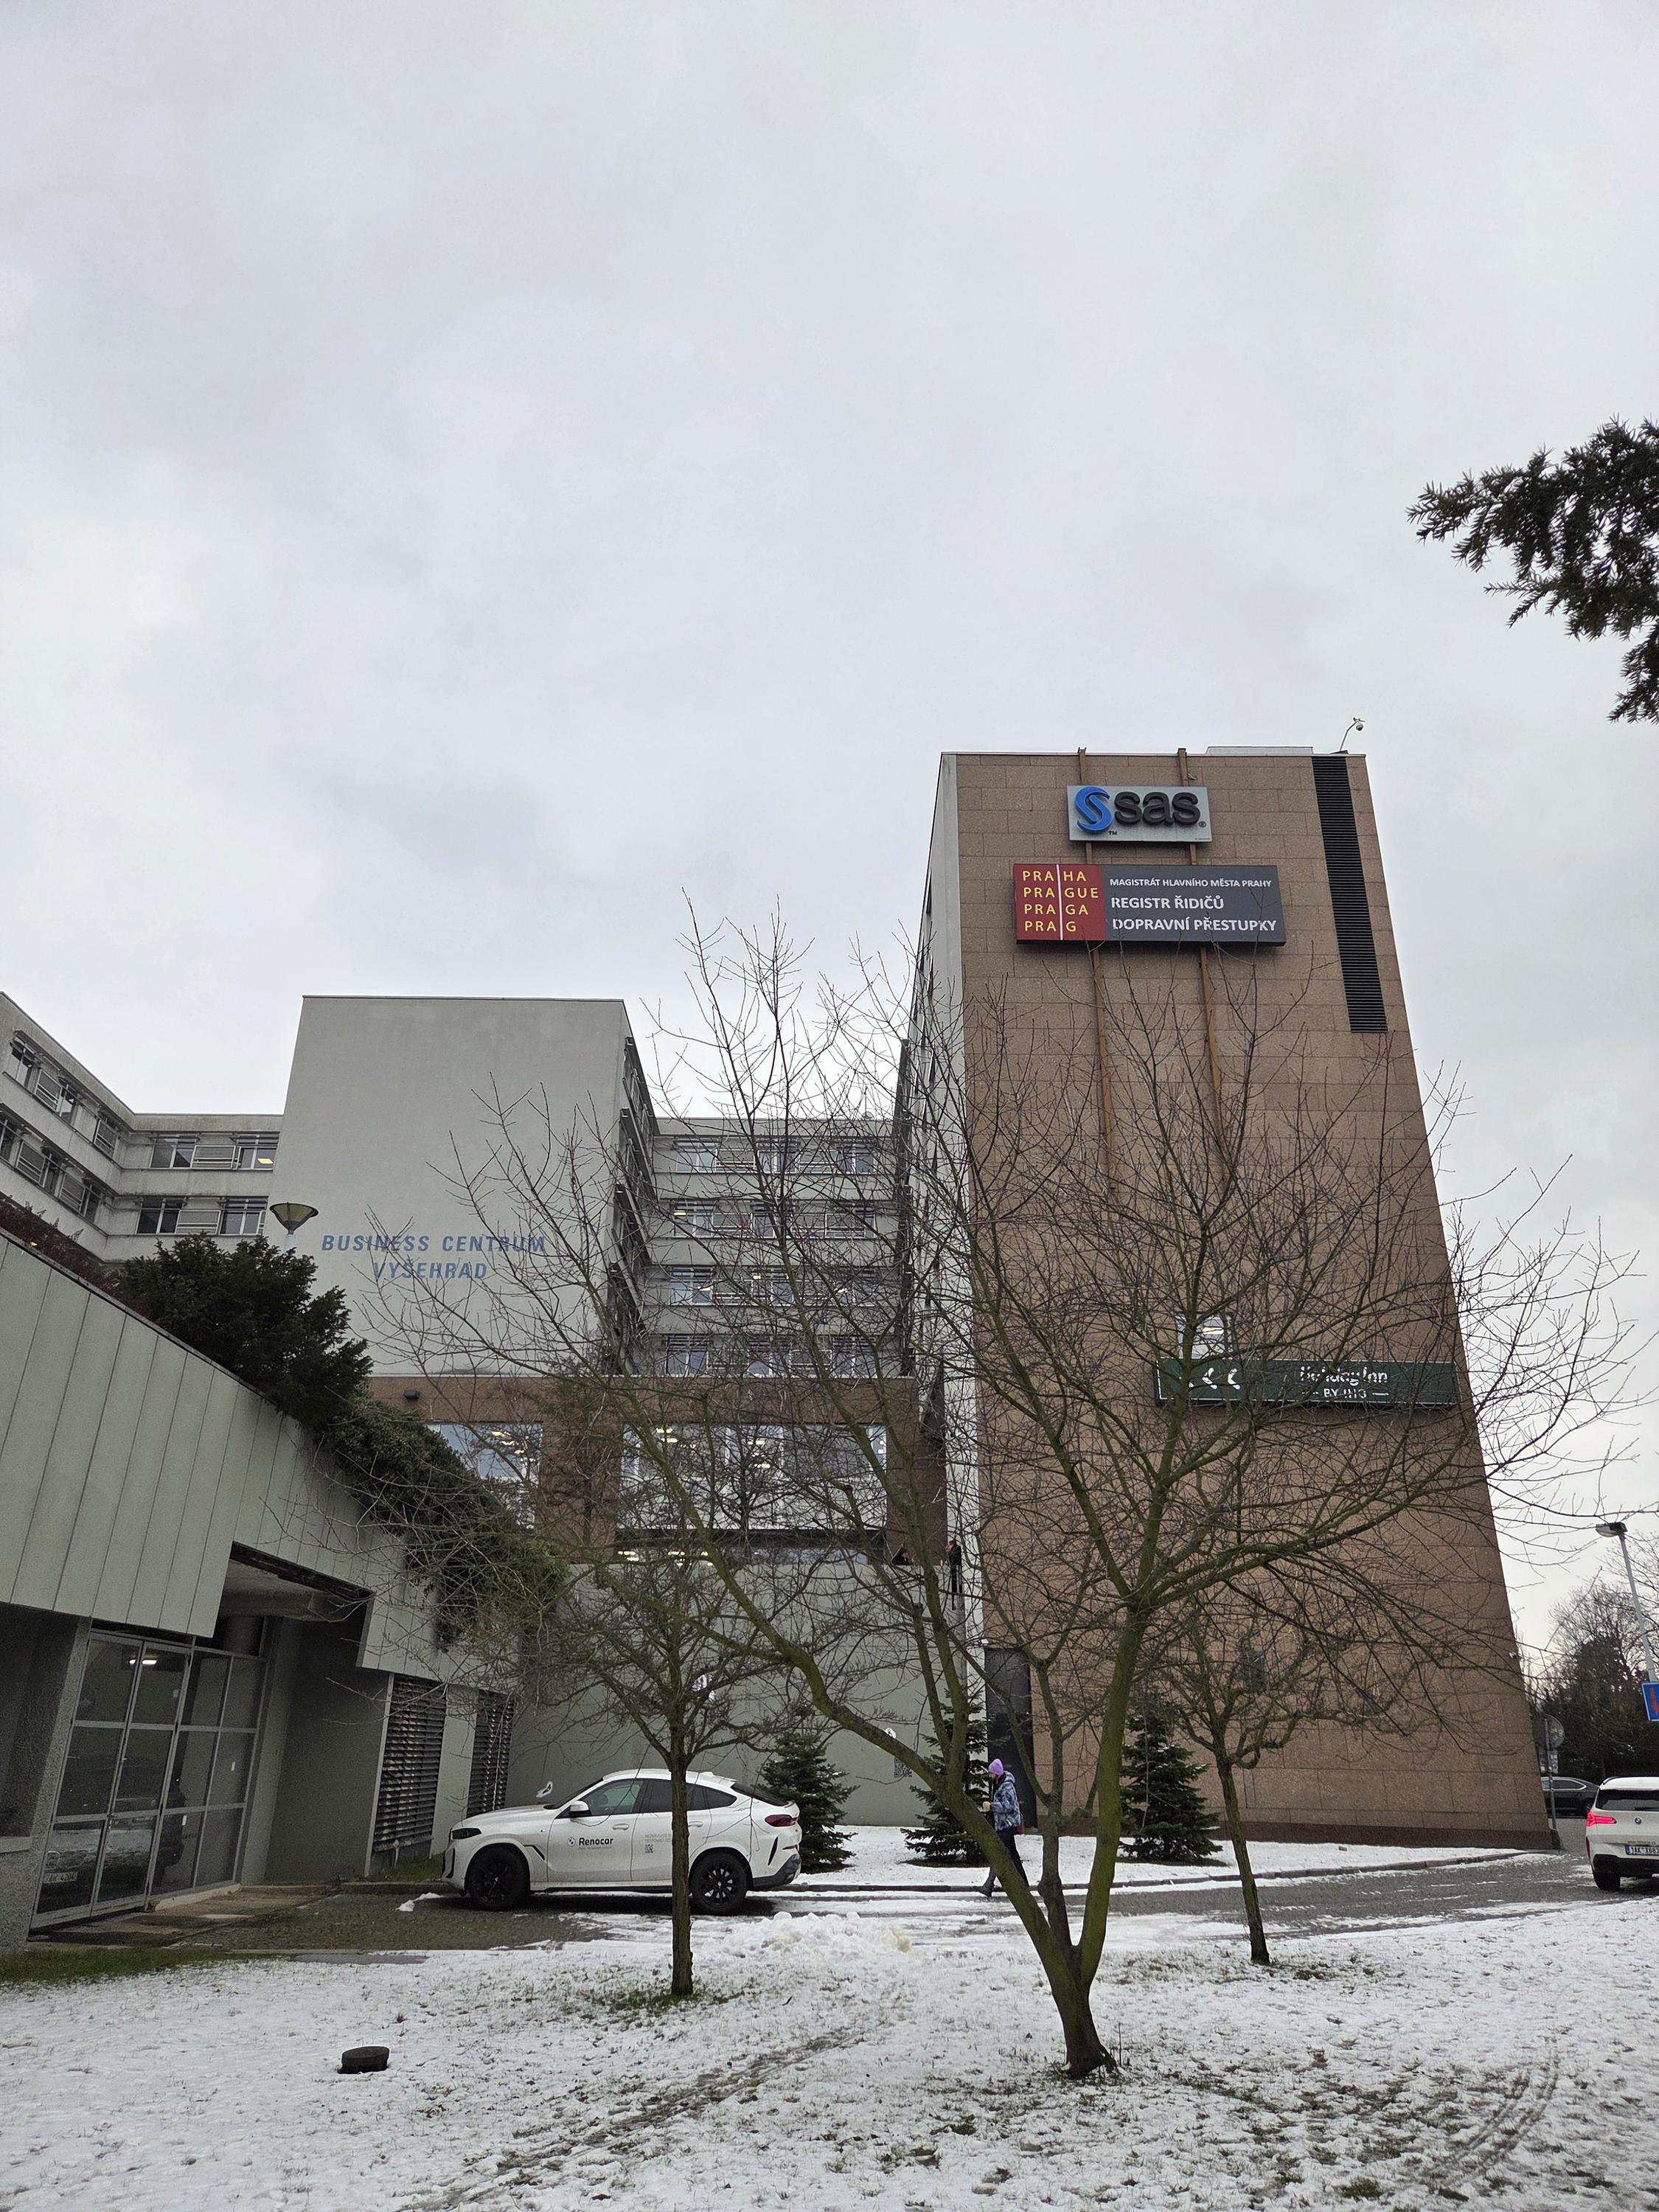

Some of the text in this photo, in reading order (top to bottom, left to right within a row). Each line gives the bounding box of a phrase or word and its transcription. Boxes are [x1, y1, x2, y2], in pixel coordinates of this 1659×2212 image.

[1114, 791, 1201, 827] sas
[1110, 877, 1272, 888] MAGISTRÁT HLAVNÍHO MĚSTA PRAHY
[1111, 895, 1224, 910] REGISTR ŘIDIČŮ
[1113, 917, 1276, 931] DOPRAVNÍ PŘESTUPKY
[321, 1235, 546, 1252] BUSINESS CENTRUM
[1300, 1366, 1360, 1387] Hoday
[579, 1837, 613, 1846] Renocar
